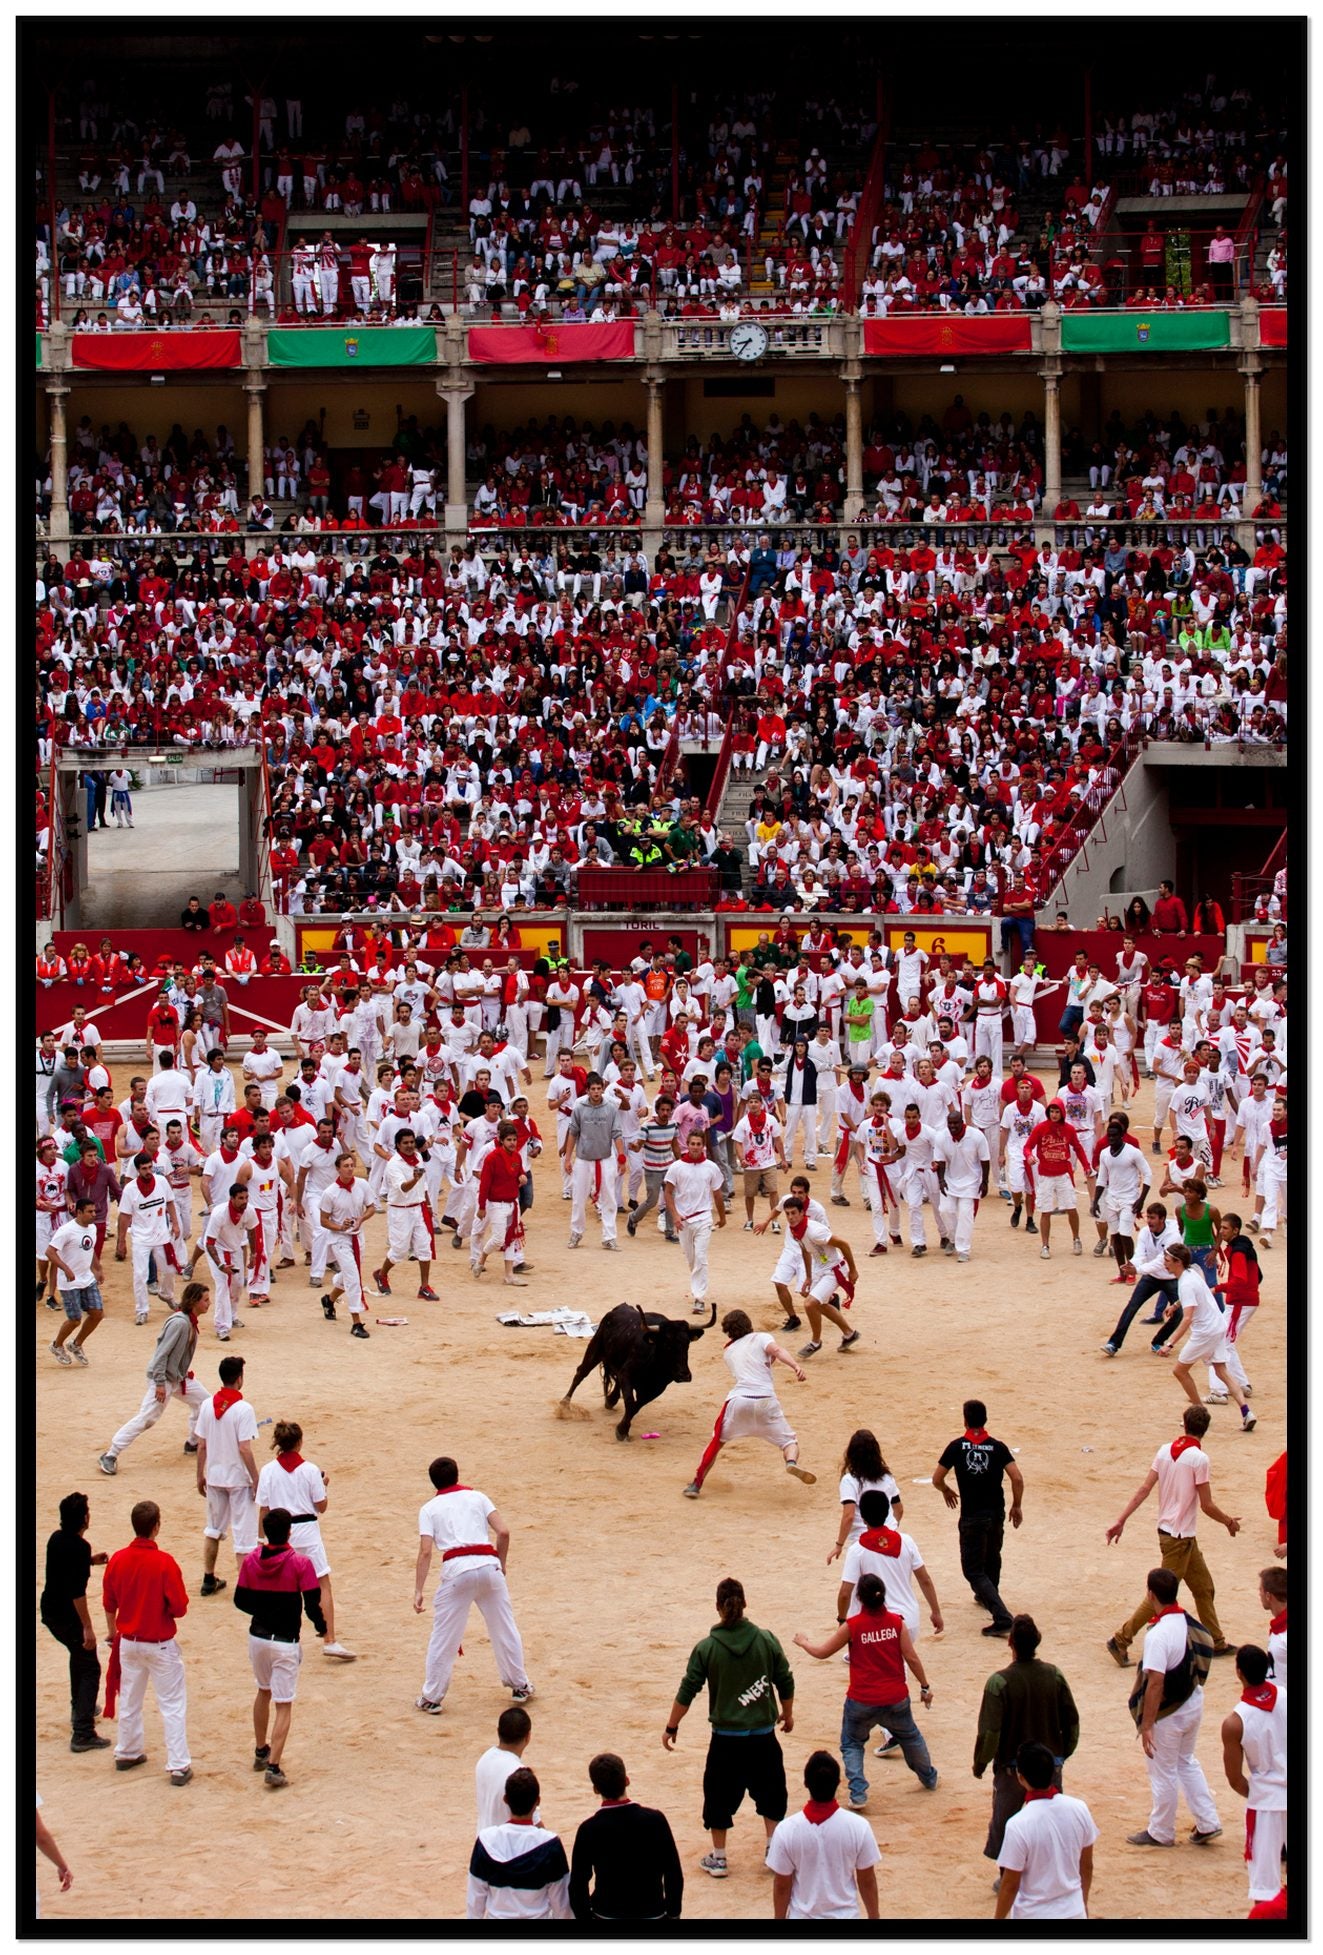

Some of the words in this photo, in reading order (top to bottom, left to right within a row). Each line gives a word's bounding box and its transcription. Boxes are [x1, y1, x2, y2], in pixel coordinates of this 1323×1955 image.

[624, 921, 659, 930] TORIL
[931, 937, 945, 953] 6
[861, 1627, 897, 1644] GALLEGA
[737, 1674, 770, 1707] INEFC
